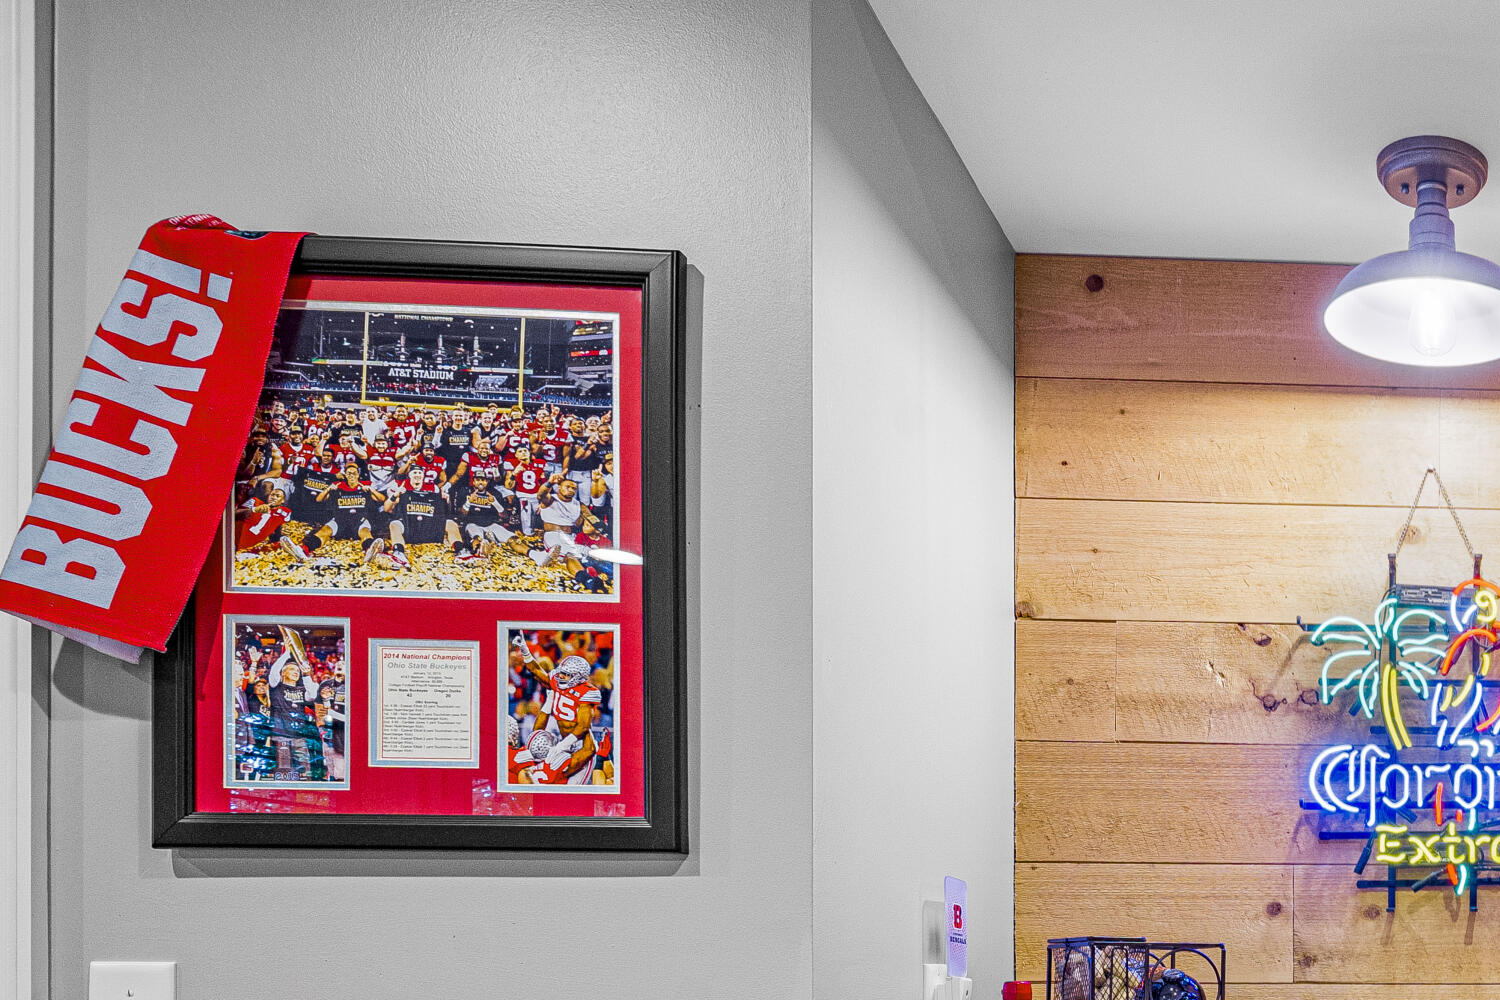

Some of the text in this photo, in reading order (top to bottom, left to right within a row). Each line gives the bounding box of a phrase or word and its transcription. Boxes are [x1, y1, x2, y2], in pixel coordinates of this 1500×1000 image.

[388, 367, 454, 380] AT&T STADIUM
[0, 249, 233, 610] BUCKS!
[393, 426, 416, 445] 37
[543, 444, 556, 461] 3
[522, 470, 536, 490] 9
[337, 497, 366, 507] CHAMPS
[407, 503, 434, 514] CHAMPS
[249, 512, 272, 536] 1
[429, 663, 467, 671] Buckeyes
[552, 693, 576, 722] 15
